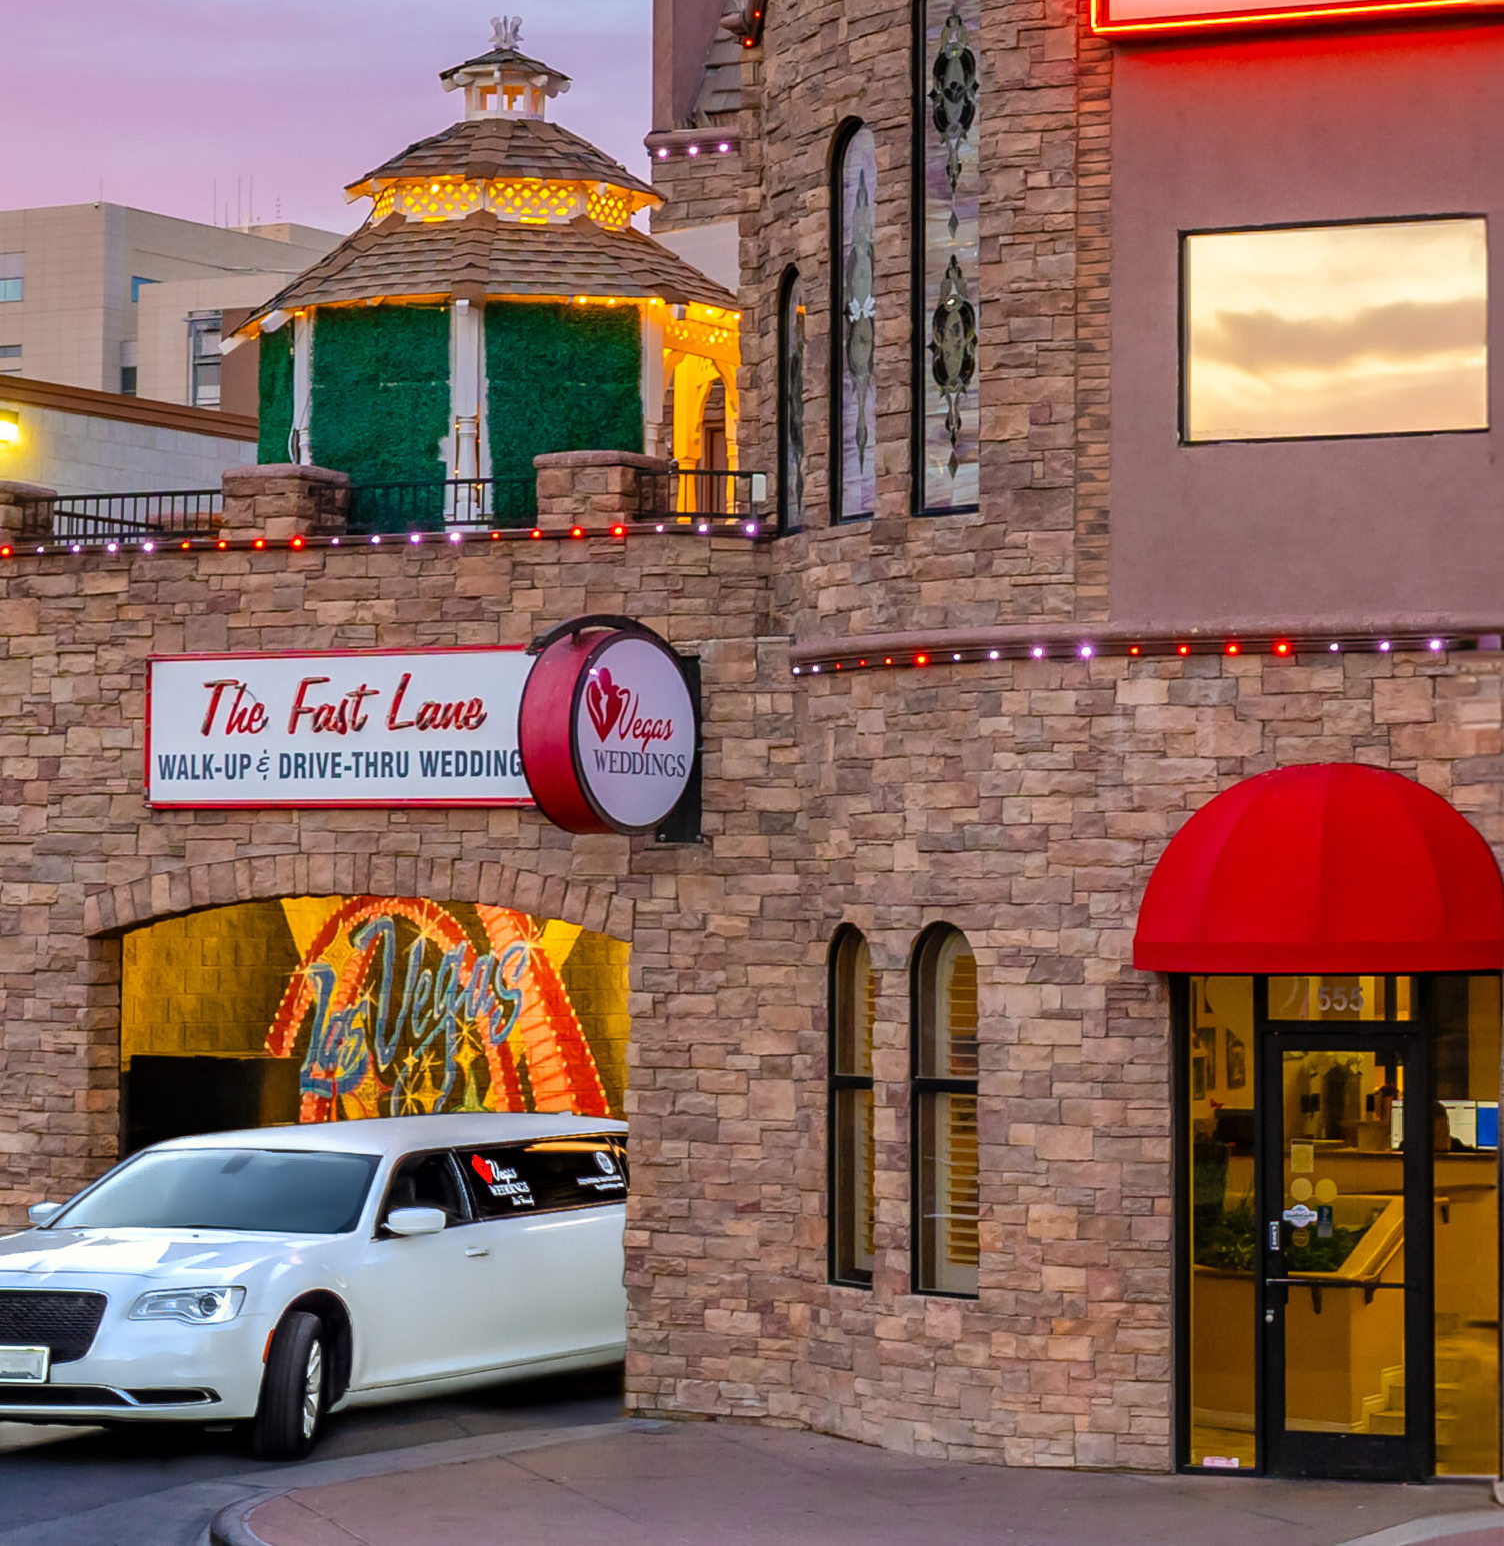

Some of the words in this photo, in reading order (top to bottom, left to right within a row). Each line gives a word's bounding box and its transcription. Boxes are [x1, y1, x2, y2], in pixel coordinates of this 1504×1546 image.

[201, 679, 269, 737] The
[287, 677, 381, 735] Fast
[385, 672, 487, 732] Lane
[617, 687, 674, 754] Vegas
[158, 753, 253, 781] WALK-UP
[279, 750, 409, 780] DRIVE-THRU
[593, 749, 686, 778] WEDDINGS
[352, 915, 531, 1117] Vegas
[1317, 985, 1364, 1012] 555
